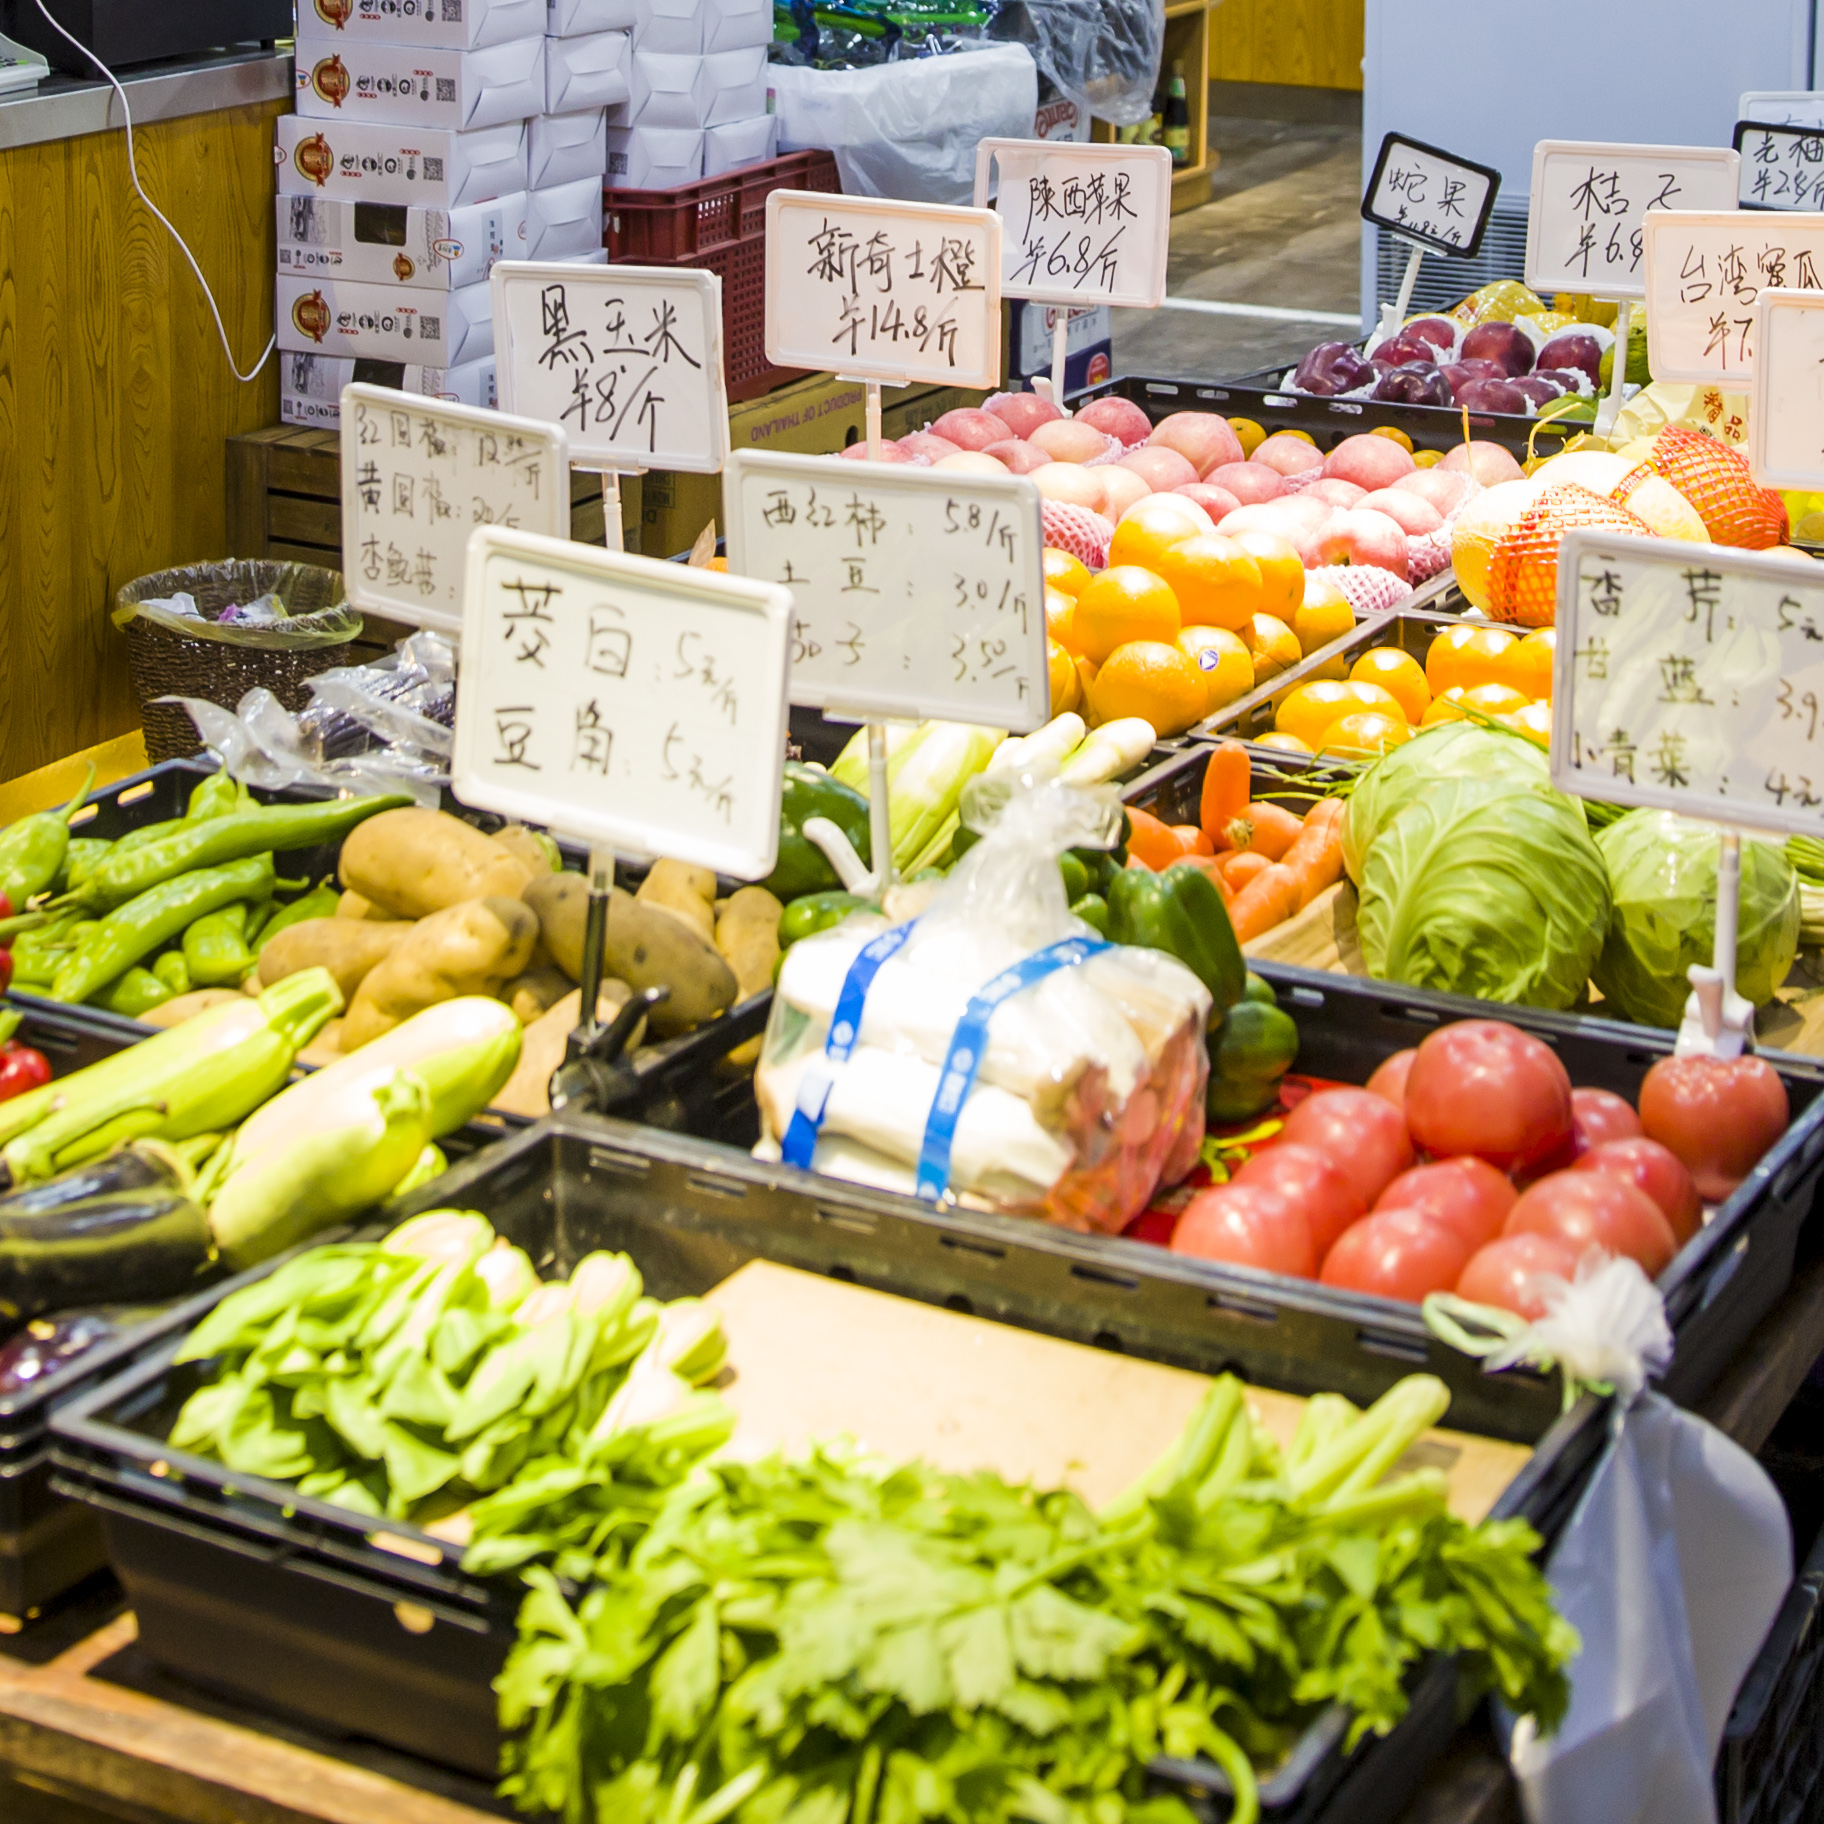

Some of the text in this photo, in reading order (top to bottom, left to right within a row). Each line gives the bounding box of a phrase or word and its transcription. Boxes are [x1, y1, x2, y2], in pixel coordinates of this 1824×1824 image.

[1389, 161, 1467, 219] 蛇果
[806, 217, 986, 295] 新奇士橙
[538, 283, 702, 371] 黑玉米
